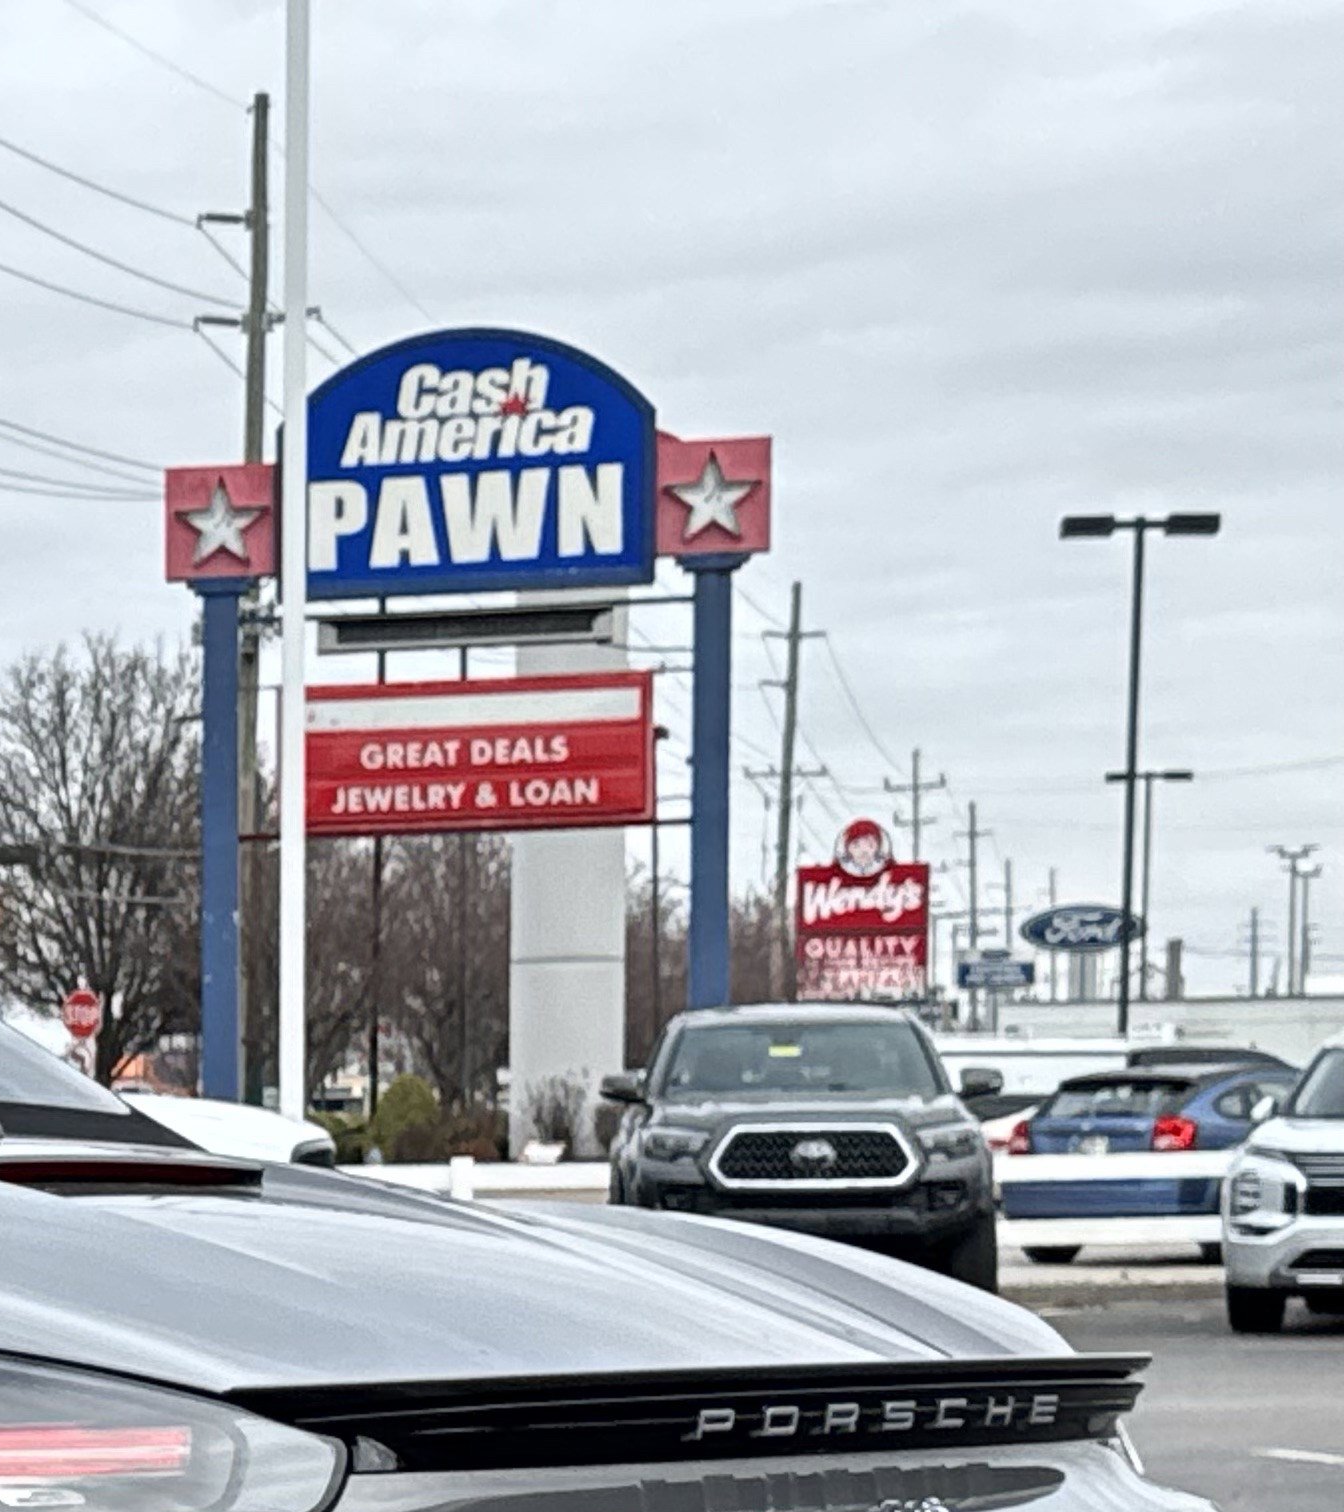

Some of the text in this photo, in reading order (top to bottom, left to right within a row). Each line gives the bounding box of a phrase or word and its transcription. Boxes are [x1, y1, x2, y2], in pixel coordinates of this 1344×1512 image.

[396, 356, 551, 420] Cash
[339, 405, 596, 469] America
[307, 461, 625, 573] PAWN
[360, 736, 570, 770] GREAT DEALS
[330, 777, 600, 814] JEWELRY & LOAN
[803, 870, 923, 925] Wendy's
[803, 934, 921, 958] QUALITY
[692, 1394, 1060, 1441] PORSCHE
